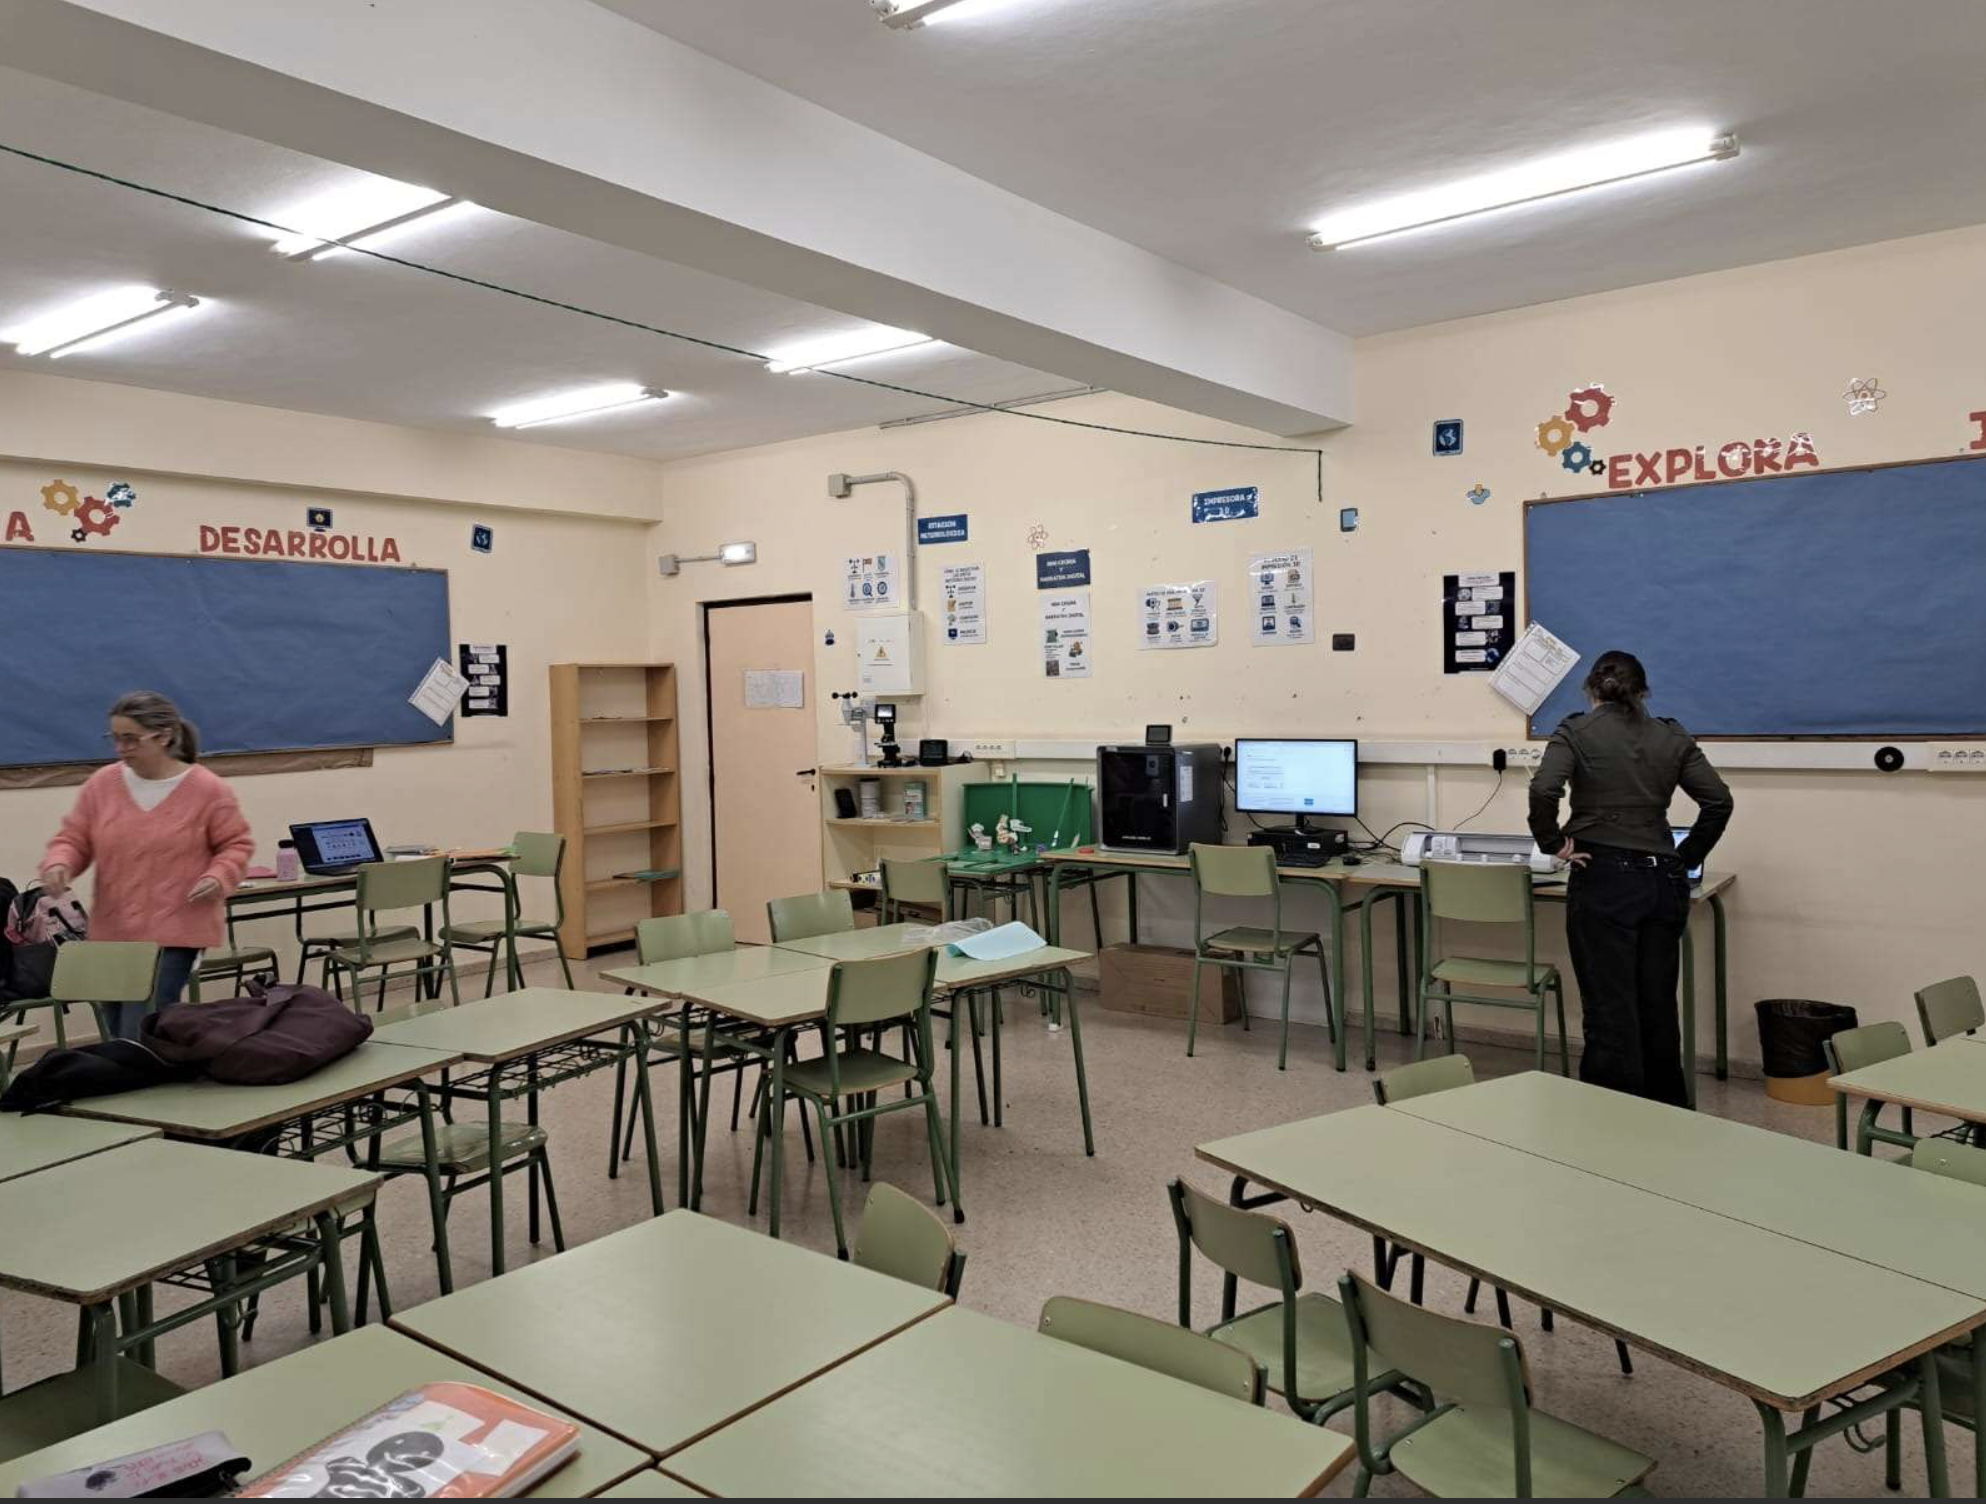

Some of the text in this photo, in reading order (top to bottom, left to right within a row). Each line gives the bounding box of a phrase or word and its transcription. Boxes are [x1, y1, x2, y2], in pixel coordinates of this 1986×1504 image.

[1608, 432, 1819, 489] EXPLORA
[5, 511, 35, 542] A
[199, 525, 401, 563] DESARROLLA
